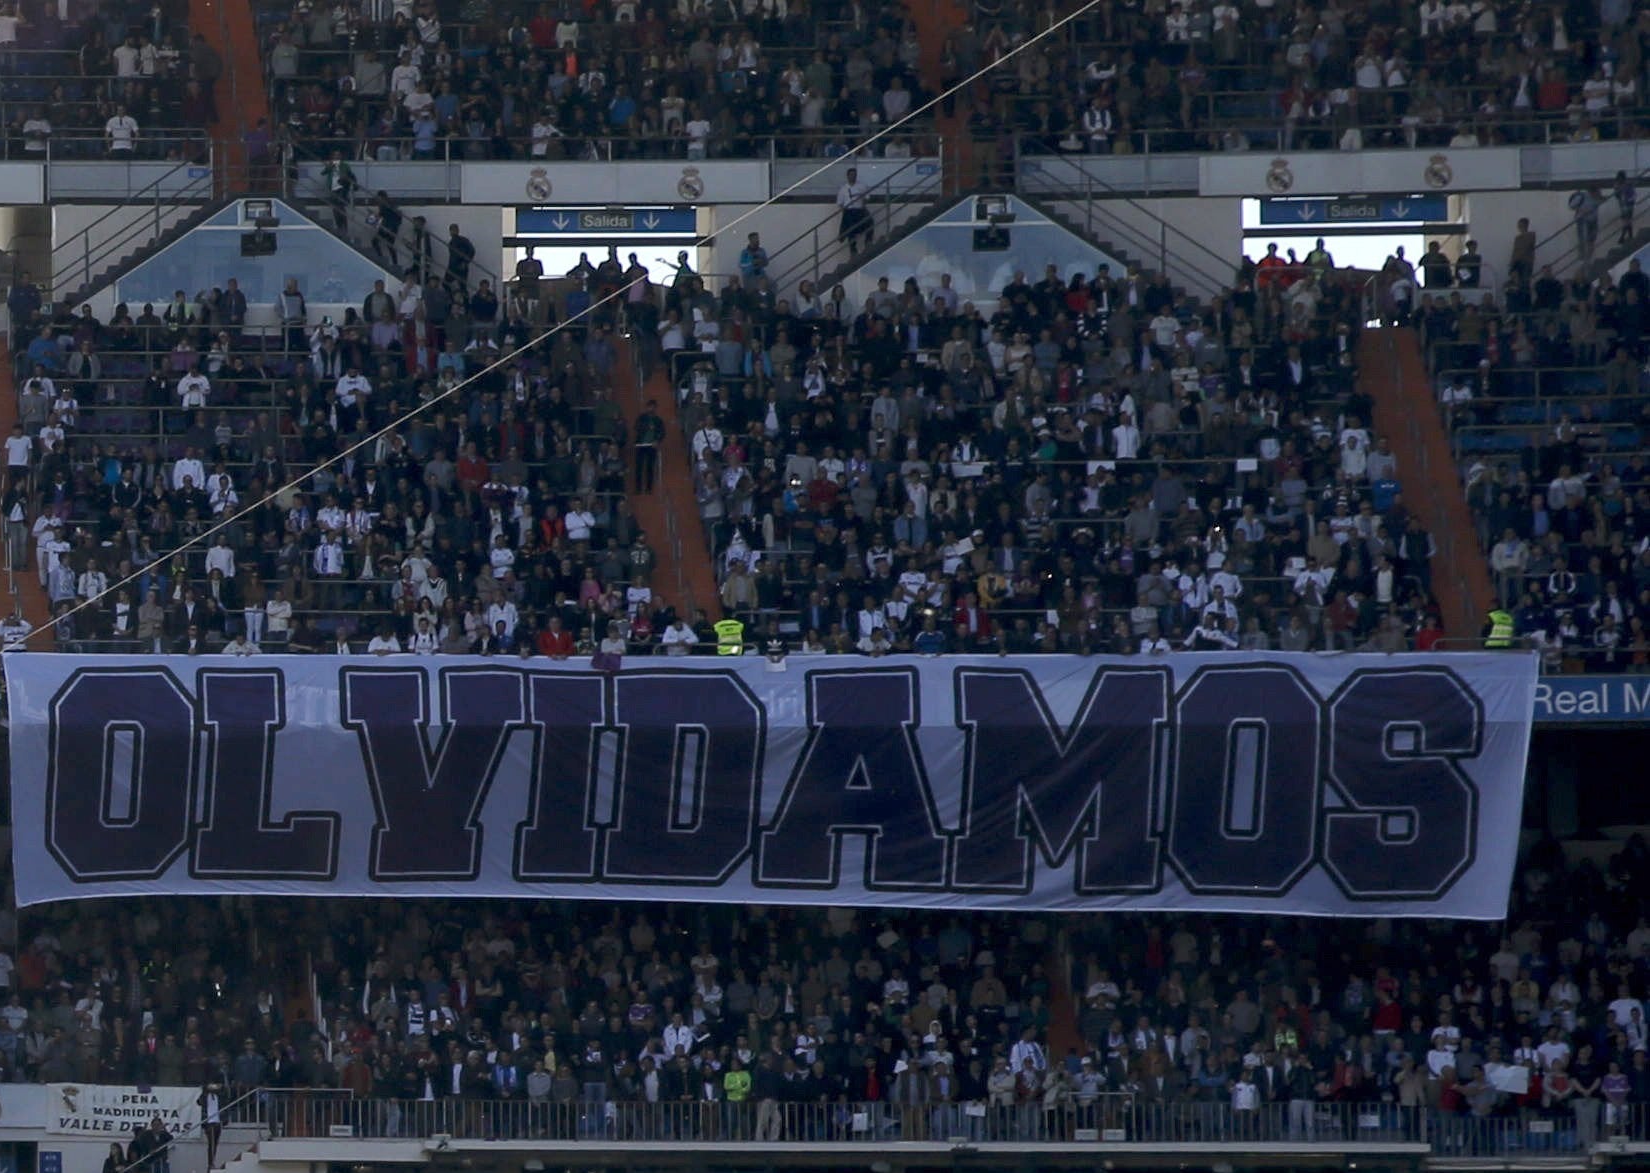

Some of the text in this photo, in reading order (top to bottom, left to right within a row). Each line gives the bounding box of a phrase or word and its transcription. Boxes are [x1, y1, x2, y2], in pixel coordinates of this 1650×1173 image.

[1330, 202, 1377, 217] Salida
[584, 213, 629, 228] Salida
[1532, 684, 1608, 713] Real
[45, 661, 1485, 901] OLVIDAMOS
[92, 1106, 180, 1119] MADRIDISTA
[59, 1117, 114, 1132] VALLE
